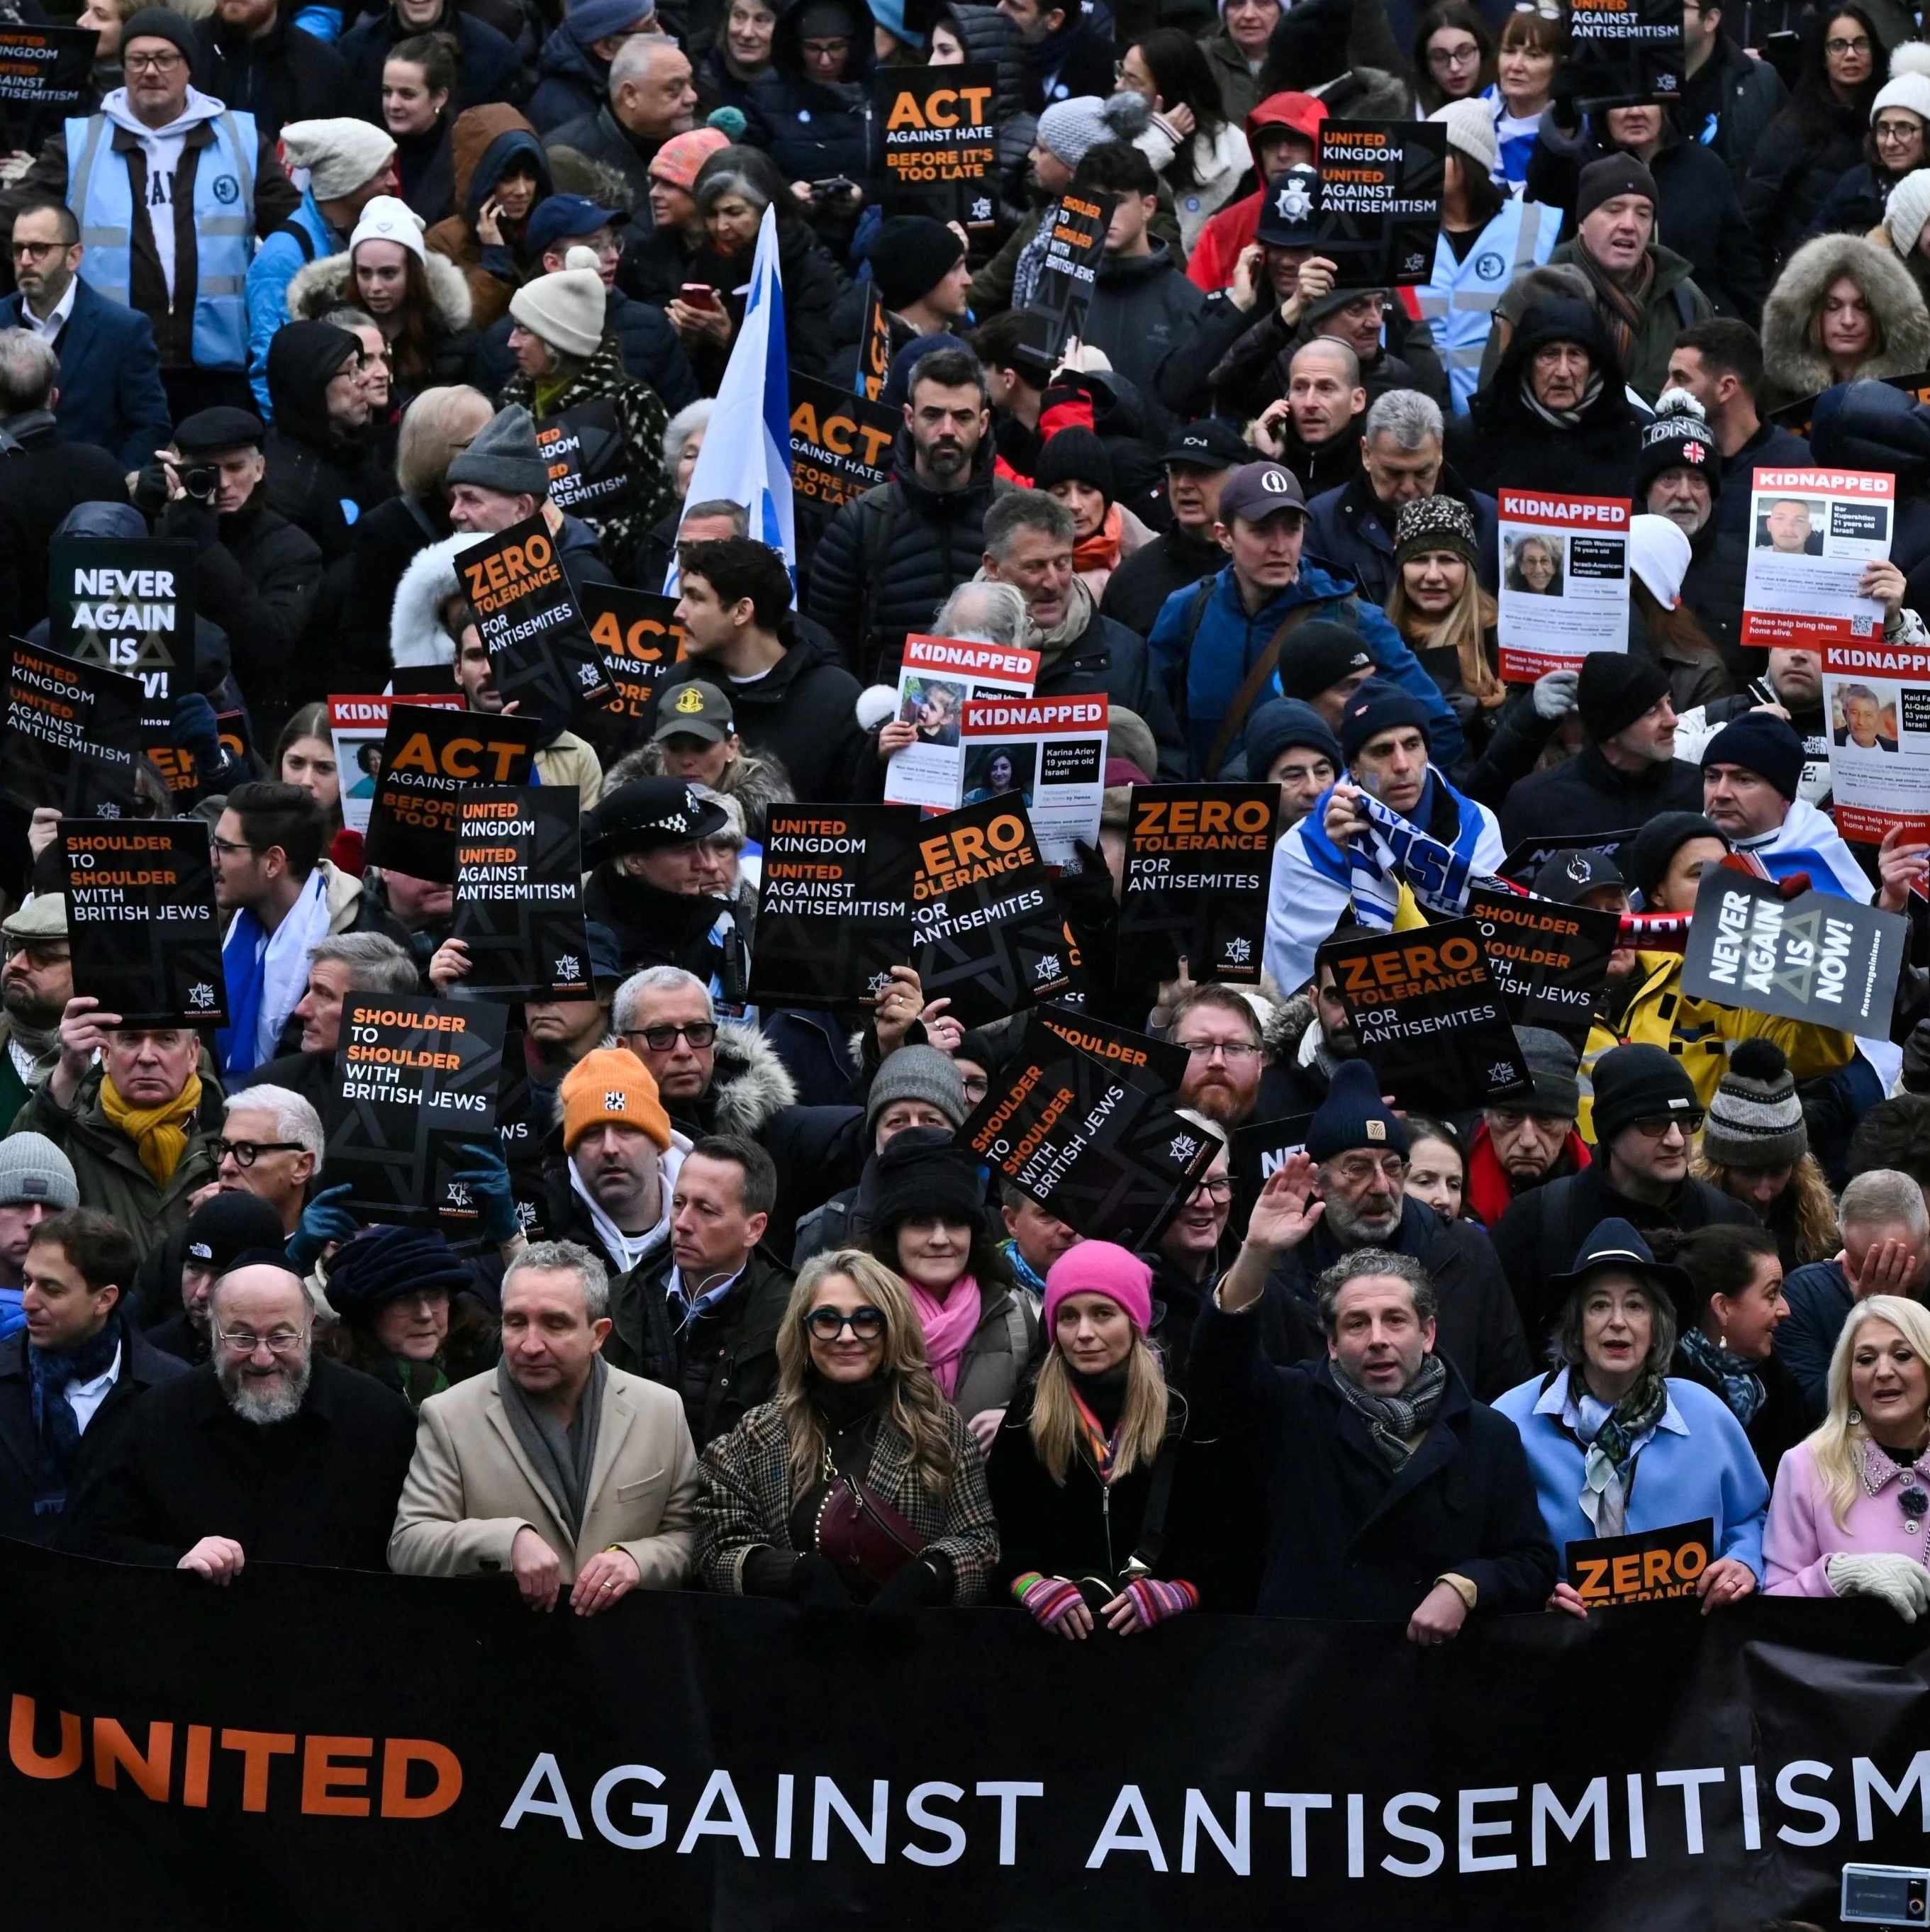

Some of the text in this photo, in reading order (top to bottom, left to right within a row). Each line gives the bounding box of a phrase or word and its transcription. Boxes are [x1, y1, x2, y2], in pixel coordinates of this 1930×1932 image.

[1572, 0, 1627, 11] UNITED
[1572, 11, 1639, 24] AGAINST
[1572, 25, 1680, 38] ANTISEMITISM
[0, 45, 59, 59] INGDOM
[0, 75, 46, 88] AINST
[0, 86, 79, 101] TISEMITISM
[887, 87, 991, 129] ACT
[887, 126, 993, 143] AGAINST HATE
[1324, 132, 1386, 146] UNITED
[887, 148, 993, 167] BEFORE IT'S
[1323, 147, 1402, 161] KINGDOM
[898, 164, 984, 181] TOO LATE
[1322, 169, 1385, 183] UNITED
[1321, 184, 1395, 198] AGAINST
[1321, 199, 1437, 213] ANTISEMITISM
[1059, 210, 1069, 224] TO
[1049, 240, 1071, 257] WITH
[1045, 254, 1095, 283] BRITISH JEWS
[789, 402, 892, 466] ACT
[789, 437, 885, 483] GAINST HATE
[554, 474, 627, 508] SEMITISM
[792, 476, 817, 496] OO
[1759, 473, 1889, 492] KIDNAPPED
[1505, 497, 1625, 523] KIDNAPPED
[465, 534, 552, 601] ZERO
[74, 568, 177, 598] NEVER
[474, 564, 562, 616] TOLERANCE
[72, 605, 175, 632] AGAIN
[481, 614, 508, 635] FOR
[488, 603, 573, 654] ANTISEMITES
[1750, 617, 1837, 632] Please help bring them
[591, 612, 688, 664] ACT
[1772, 628, 1792, 637] alive.
[109, 638, 138, 665] IS
[910, 642, 1032, 674] KIDNAPPED
[1827, 647, 1930, 672] KIDNAPP
[13, 651, 79, 684] UNITED
[604, 655, 651, 675] AINST
[1544, 659, 1562, 669] bring
[1563, 660, 1583, 669] them
[11, 666, 95, 705] KINGDOM
[9, 686, 74, 719] UNITED
[8, 700, 85, 737] AGAINST
[969, 703, 1102, 727] KIDNAPPED
[6, 715, 130, 764] ANTISEMITISM
[391, 732, 526, 782] ACT
[1047, 748, 1073, 757] Karina
[1057, 758, 1079, 768] years
[1081, 757, 1094, 766] old
[387, 771, 468, 791] AGAINST
[1045, 768, 1069, 776] Israeli
[382, 791, 457, 815] BEFOR
[463, 803, 518, 819] UNITED
[393, 809, 439, 829] TOO
[771, 819, 847, 835] UNITED
[1134, 800, 1271, 834] ZERO
[1842, 811, 1865, 821] Please
[1867, 815, 1882, 825] help
[1843, 820, 1883, 834] home alive.
[461, 820, 535, 837] KINGDOM
[67, 837, 172, 851] SHOULDER
[770, 837, 866, 854] KINGDOM
[915, 814, 1025, 881] ERO
[1132, 834, 1268, 852] TOLERANCE
[68, 854, 95, 869] TO
[459, 849, 517, 864] UNITED
[1130, 858, 1171, 873] FOR
[70, 871, 177, 886] SHOULDER
[457, 866, 528, 882] AGAINST
[768, 864, 843, 880] UNITED
[913, 846, 1034, 900] OLERANCE
[457, 884, 576, 900] ANTISEMITISM
[766, 881, 855, 898] AGAINST
[1127, 873, 1259, 892] ANTISEMITES
[72, 888, 124, 903] WITH
[74, 905, 211, 922] BRITISH JEWS
[764, 899, 905, 917] ANTISEMITISM
[913, 889, 1044, 947] ANTISEMITES
[1474, 903, 1580, 936] SHOULDER
[1709, 890, 1751, 985] NEVER
[1745, 899, 1785, 995] AGAIN
[1785, 938, 1815, 967] IS
[1815, 917, 1854, 1004] NOW!
[1339, 937, 1478, 990] ZERO
[1860, 929, 1882, 1017] #neveragainisnow
[1347, 967, 1488, 1007] TOLERANCE
[1536, 985, 1591, 1005] JEWS
[352, 1007, 466, 1032] SHOULDER
[1354, 1008, 1398, 1027] FOR
[1362, 1005, 1496, 1044] ANTISEMITES
[351, 1026, 379, 1044] TO
[347, 1045, 461, 1070] SHOULDER
[345, 1063, 401, 1083] WITH
[342, 1082, 487, 1112] BRITISH JEWS
[605, 1092, 625, 1101] HU
[605, 1101, 625, 1110] GO
[971, 1065, 1044, 1153] SHOULDER
[1002, 1088, 1075, 1176] SHOULDER
[1032, 1085, 1125, 1199] BRITISH JEWS
[986, 1139, 1010, 1163] TO
[1017, 1141, 1058, 1185] WITH
[1575, 1541, 1707, 1599] ZERO
[8, 1694, 1930, 1879] UNITED AGAINST ANTISEMITISM
